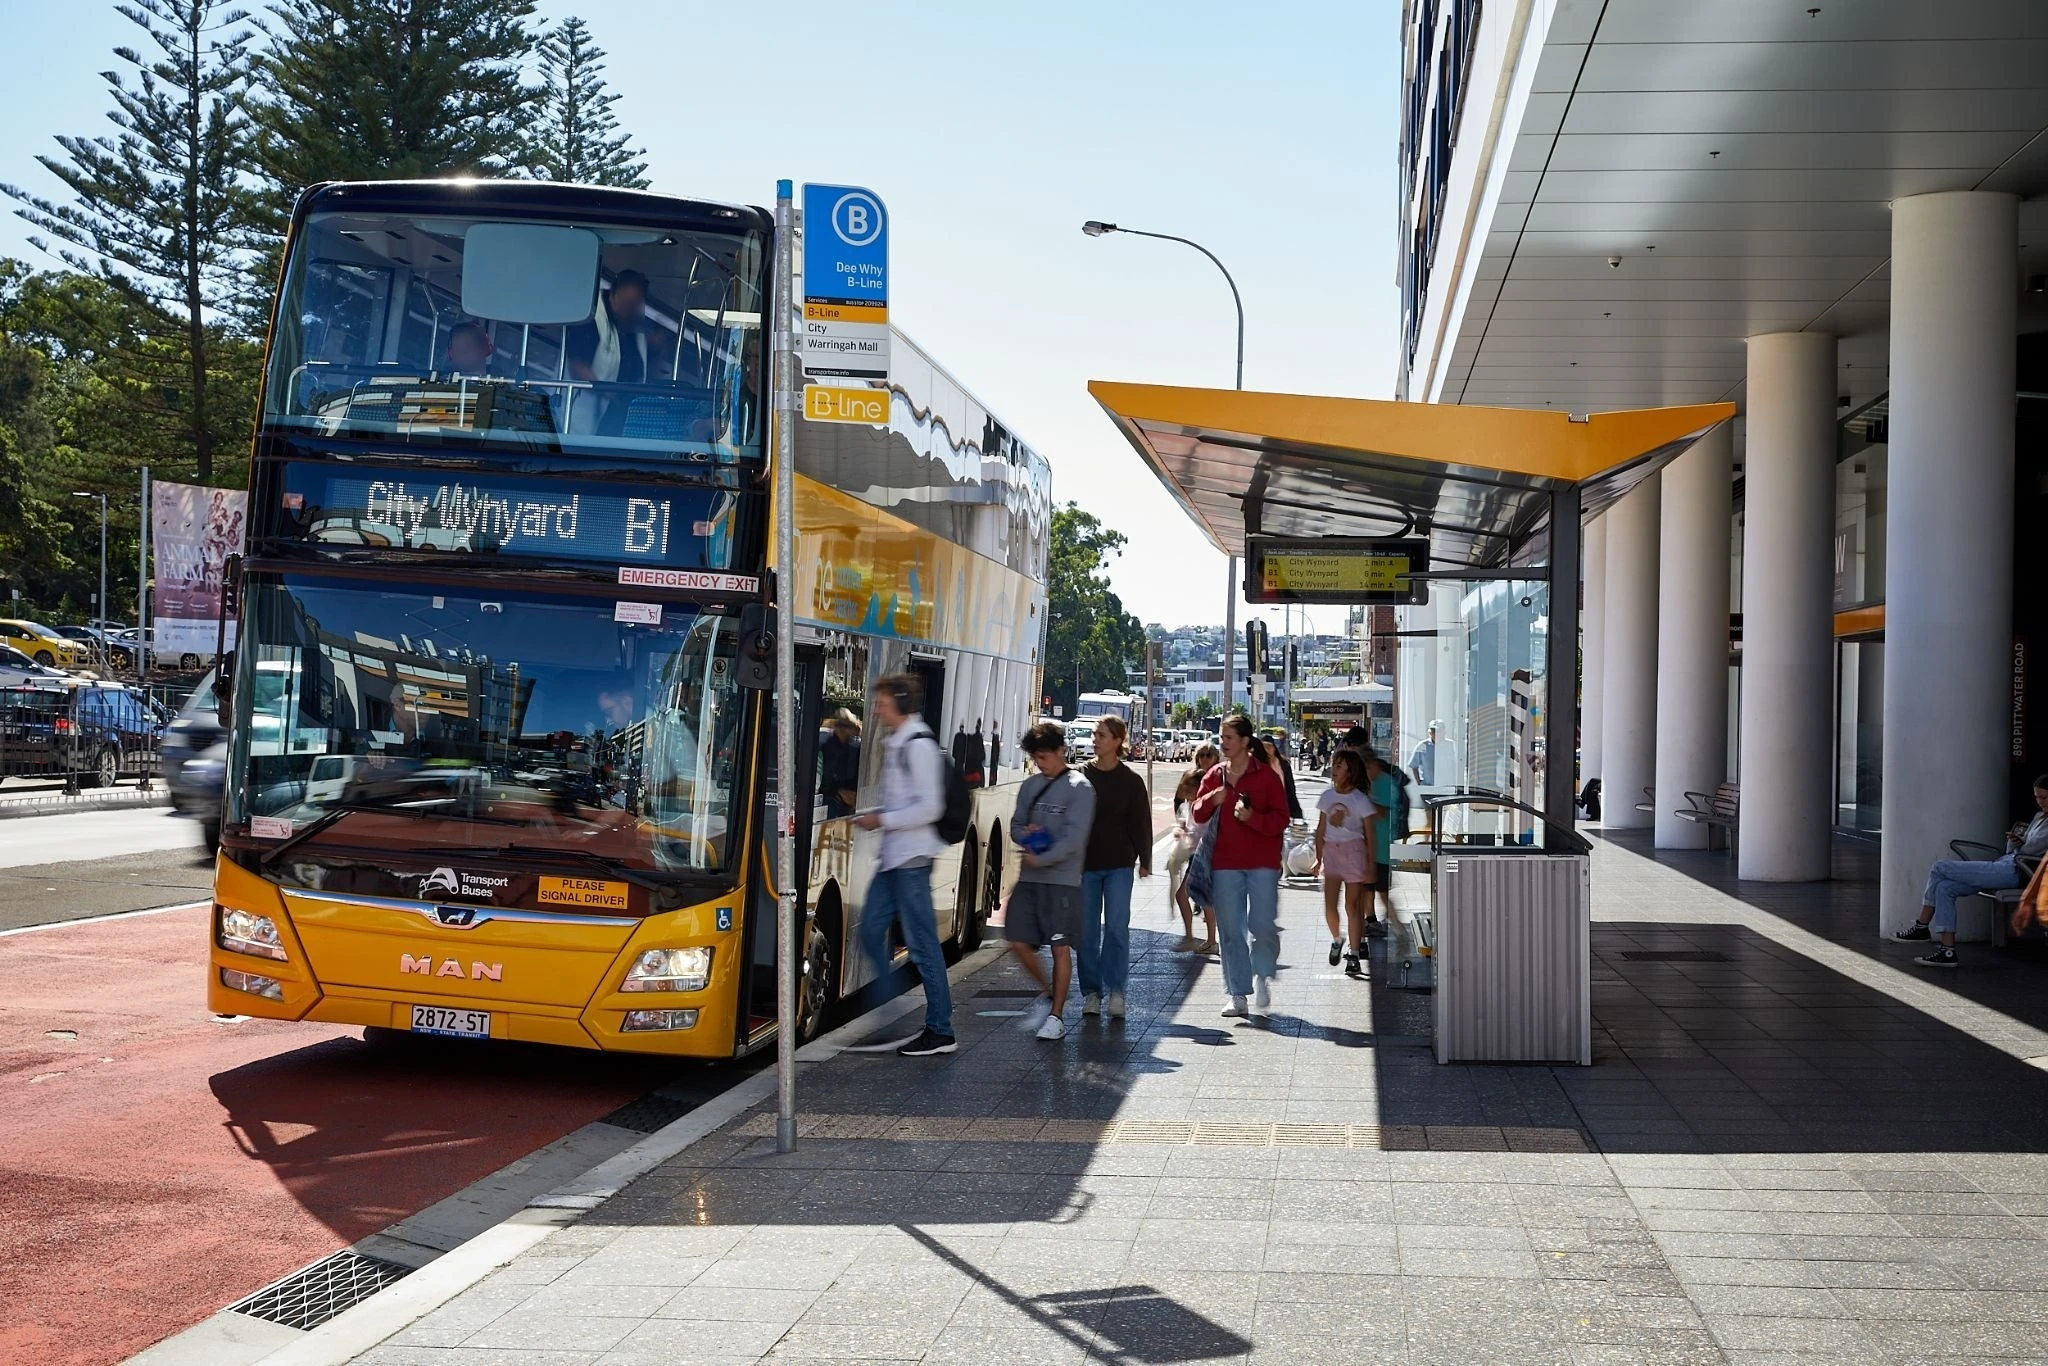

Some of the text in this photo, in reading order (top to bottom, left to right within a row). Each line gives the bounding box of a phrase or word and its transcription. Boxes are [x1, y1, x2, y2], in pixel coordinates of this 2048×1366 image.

[848, 205, 868, 234] B
[836, 262, 883, 277] Dee Why
[847, 276, 883, 288] B-Line
[807, 296, 828, 304] Services
[808, 307, 840, 318] B-Line
[808, 323, 827, 334] City
[808, 339, 878, 352] Warringah Mall
[367, 481, 671, 554] City Wynyard B1
[1289, 559, 1304, 567] City
[1305, 558, 1339, 567] Wynyard
[162, 561, 205, 581] FARM
[1289, 569, 1304, 578] City
[1305, 569, 1339, 578] Wynyard
[621, 569, 757, 592] EMERGENCY EXIT
[1289, 580, 1304, 588] City
[1305, 580, 1338, 589] Wynyard
[2013, 643, 2024, 757] 890 PITTWATER ROAD
[461, 873, 509, 888] Transport
[562, 879, 605, 892] PLEASE
[461, 885, 493, 898] Buses
[541, 890, 625, 906] SIGNAL DRIVER
[400, 953, 503, 982] MAN
